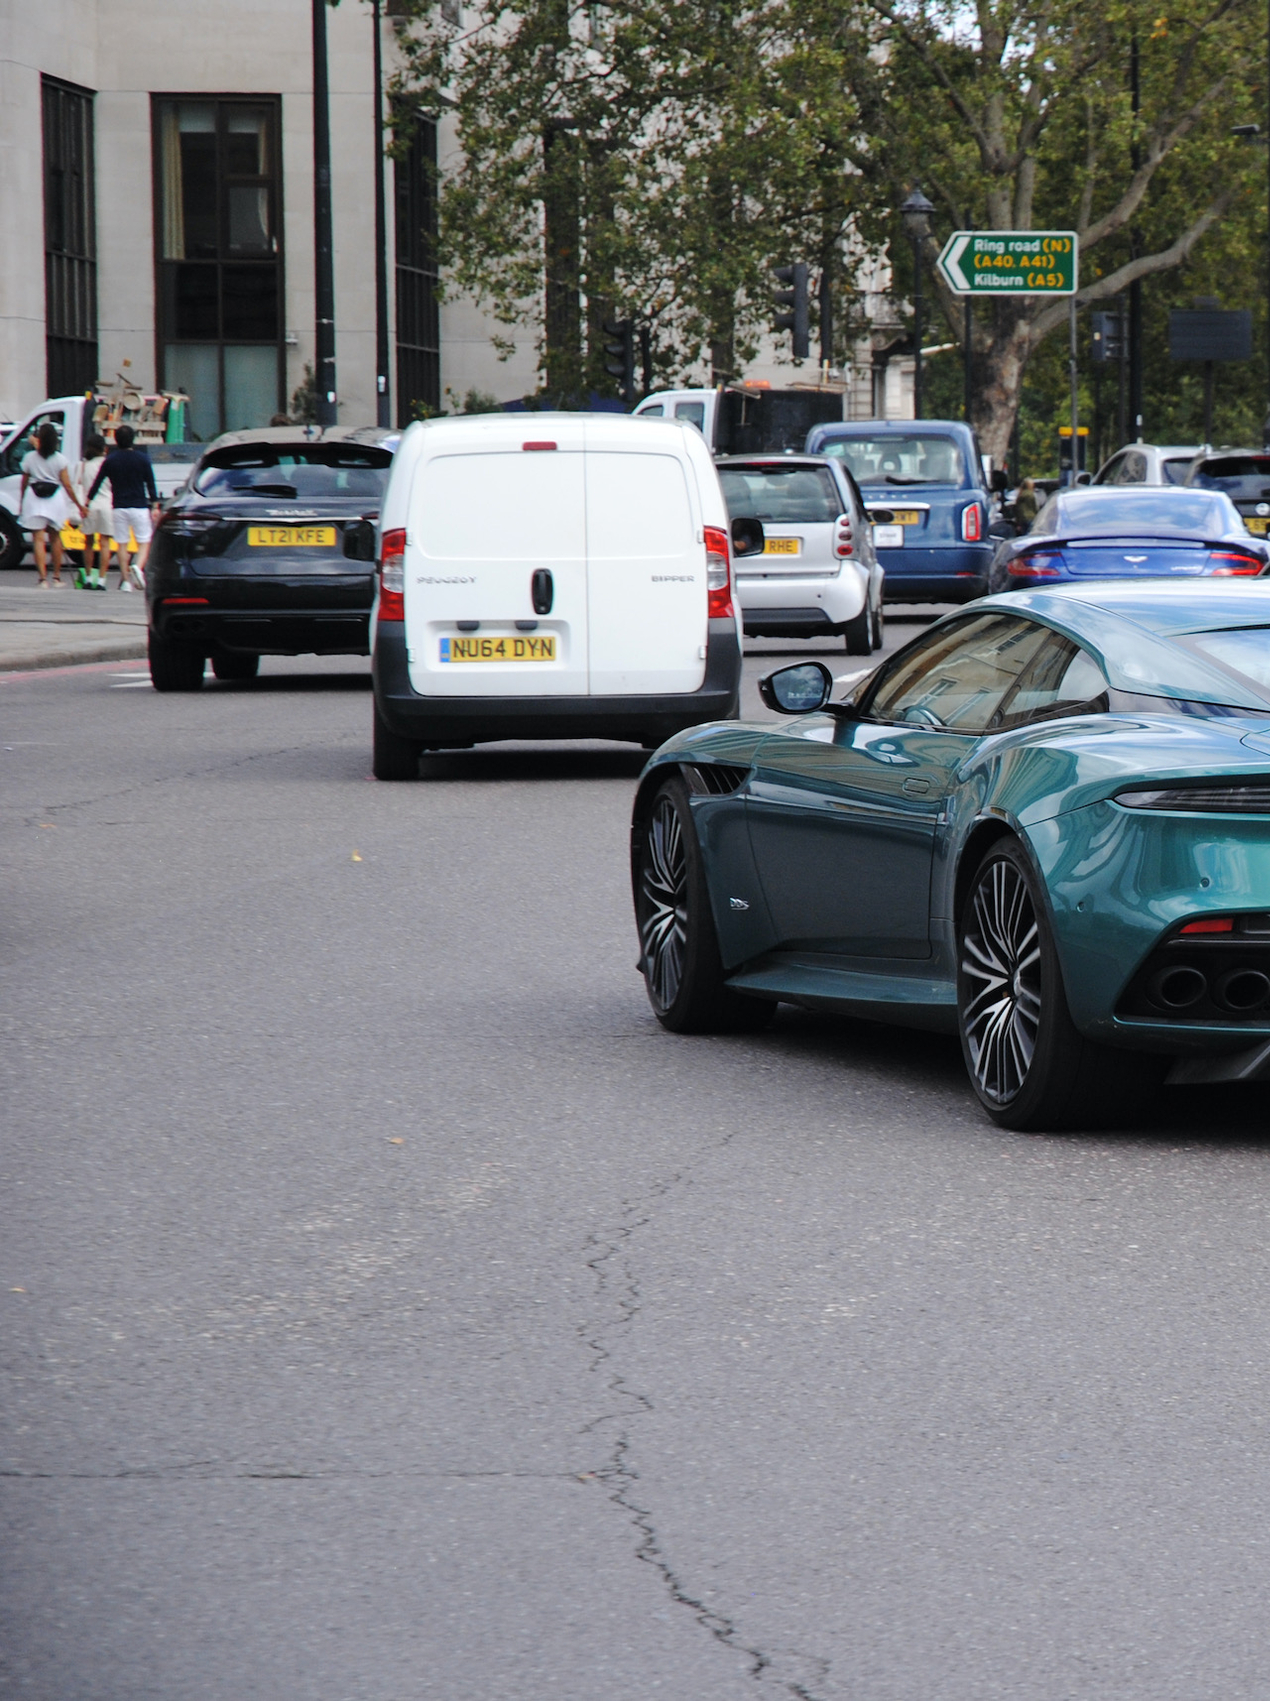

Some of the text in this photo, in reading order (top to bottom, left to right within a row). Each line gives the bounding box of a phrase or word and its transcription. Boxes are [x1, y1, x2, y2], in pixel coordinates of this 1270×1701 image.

[974, 238, 1071, 253] Ring road (N)
[1020, 254, 1055, 269] A41)
[974, 272, 1064, 287] Kilburn (A5)
[296, 530, 325, 543] KFE
[769, 540, 793, 552] RHE
[453, 638, 553, 658] NU64 DYN
